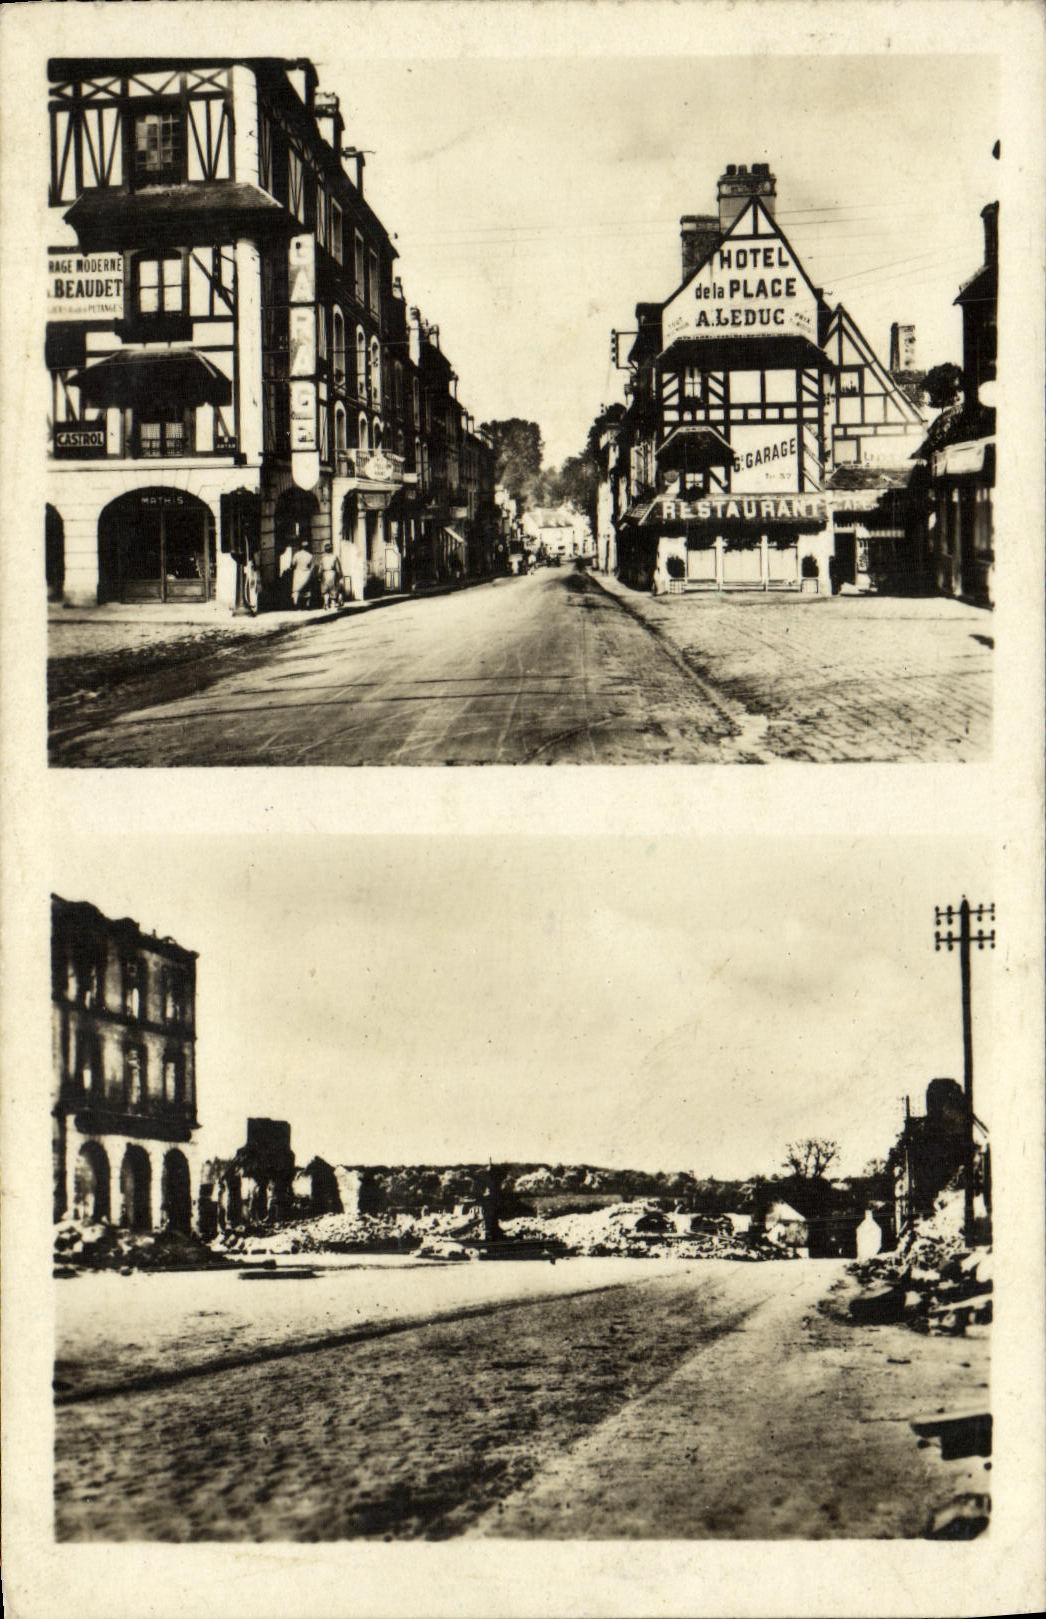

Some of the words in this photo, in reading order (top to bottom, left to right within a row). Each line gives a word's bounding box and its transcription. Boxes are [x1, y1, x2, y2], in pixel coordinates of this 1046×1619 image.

[76, 257, 122, 272] MODERNE
[719, 247, 789, 269] HOTEL
[54, 279, 123, 298] BEAUDET
[729, 278, 797, 298] PLACE
[56, 432, 104, 447] CASTROL
[745, 437, 796, 469] GARAGE
[662, 499, 821, 518] RESTAURANT
